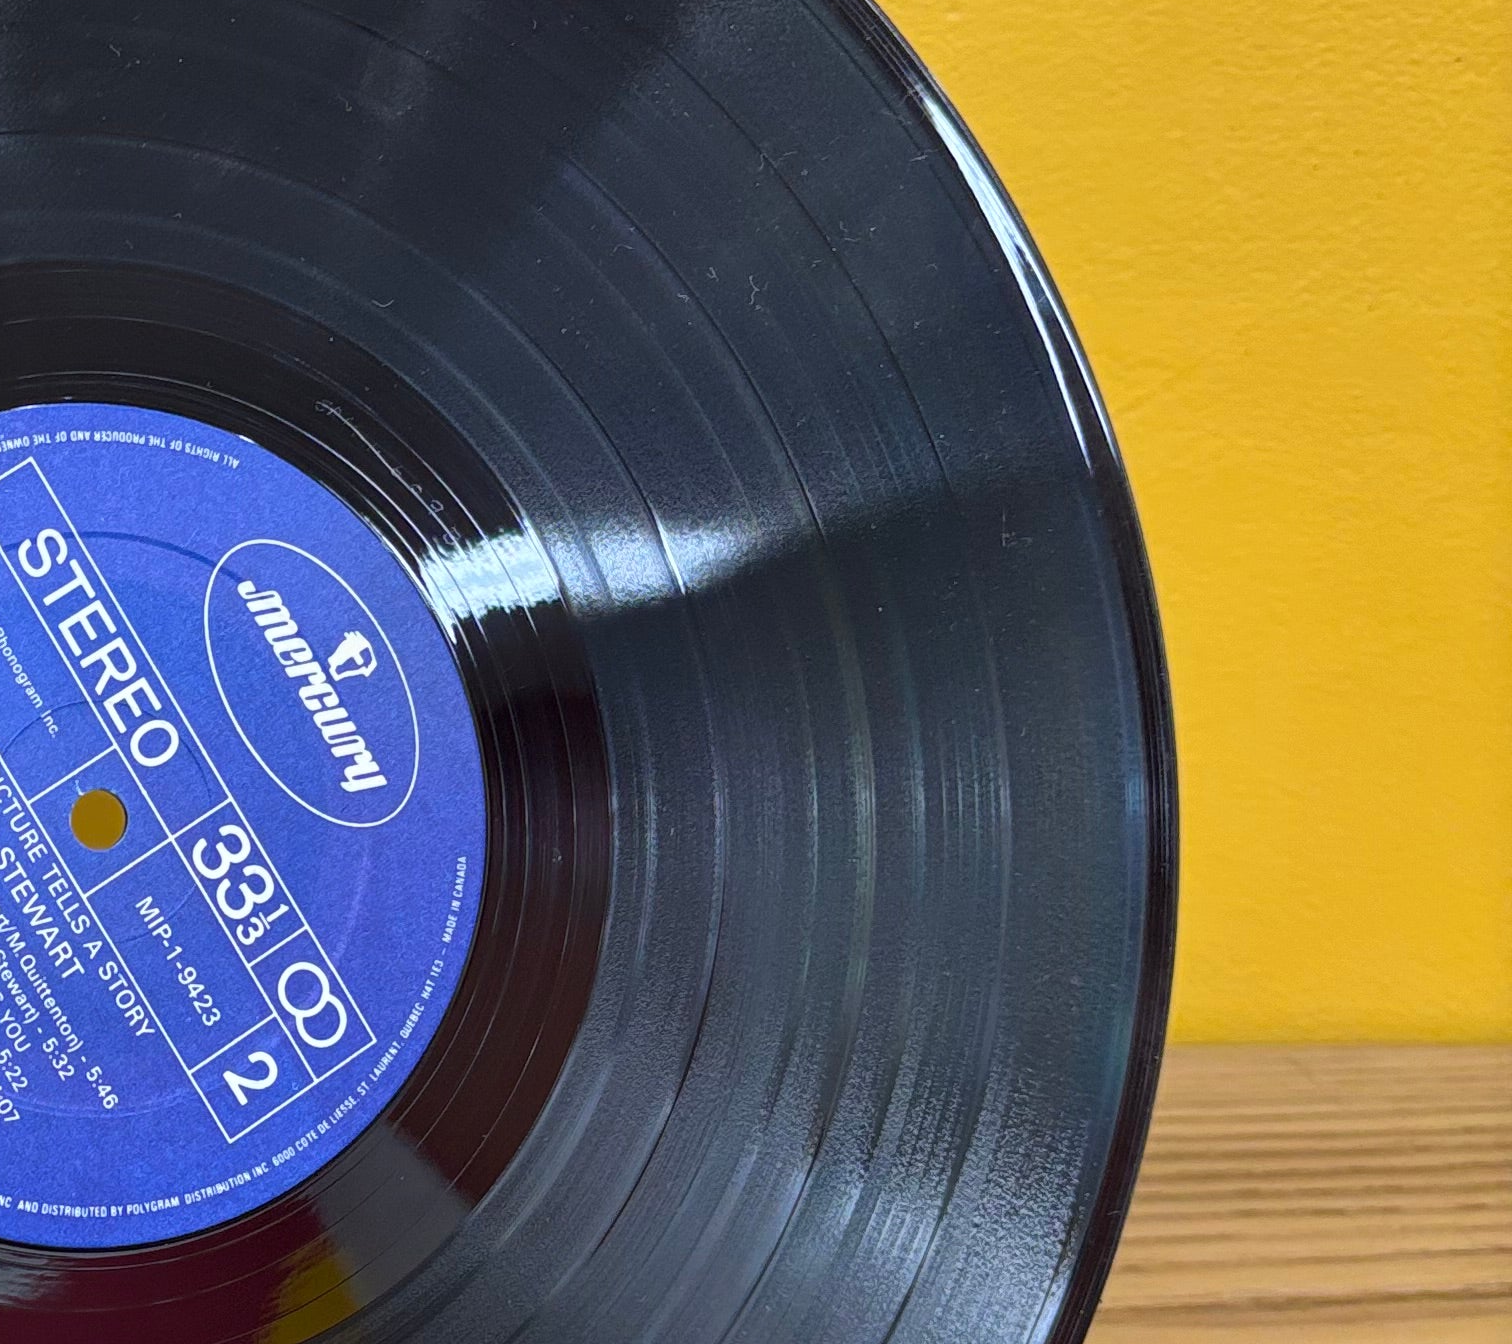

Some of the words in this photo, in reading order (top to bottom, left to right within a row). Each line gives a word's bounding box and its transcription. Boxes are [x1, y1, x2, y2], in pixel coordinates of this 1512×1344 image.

[31, 432, 53, 447] THE
[53, 429, 69, 444] OF
[69, 429, 92, 443] AND
[92, 429, 147, 446] PRODUCER
[146, 433, 167, 450] THE
[168, 438, 184, 453] OF
[183, 441, 222, 464] RIGHTS
[221, 453, 241, 470] ALL
[16, 527, 181, 768] STEREO
[236, 579, 389, 794] mercury
[40, 709, 59, 739] Inc.
[451, 855, 468, 899] CANADA
[449, 898, 462, 913] IN
[440, 913, 459, 945] MADE
[41, 861, 92, 936] TELLS
[81, 939, 104, 961] A
[97, 959, 157, 1038] STORY
[134, 894, 222, 1028] MIP-1-9423
[429, 958, 445, 978] 1E3
[419, 977, 437, 1001] H4T
[398, 1001, 426, 1040] QUEBEC
[41, 1036, 76, 1082] 5:32
[85, 1064, 120, 1110] 5:46
[221, 1050, 279, 1107] 2
[315, 1118, 333, 1136] DE
[294, 1128, 320, 1153] COTE
[270, 1145, 297, 1168] 6000
[183, 1171, 253, 1206] DISTRIBUTION
[15, 1198, 40, 1215] AND
[40, 1202, 109, 1219] DISTRIBUTED
[109, 1204, 125, 1218] BY
[125, 1194, 181, 1216] POLYGRAM
